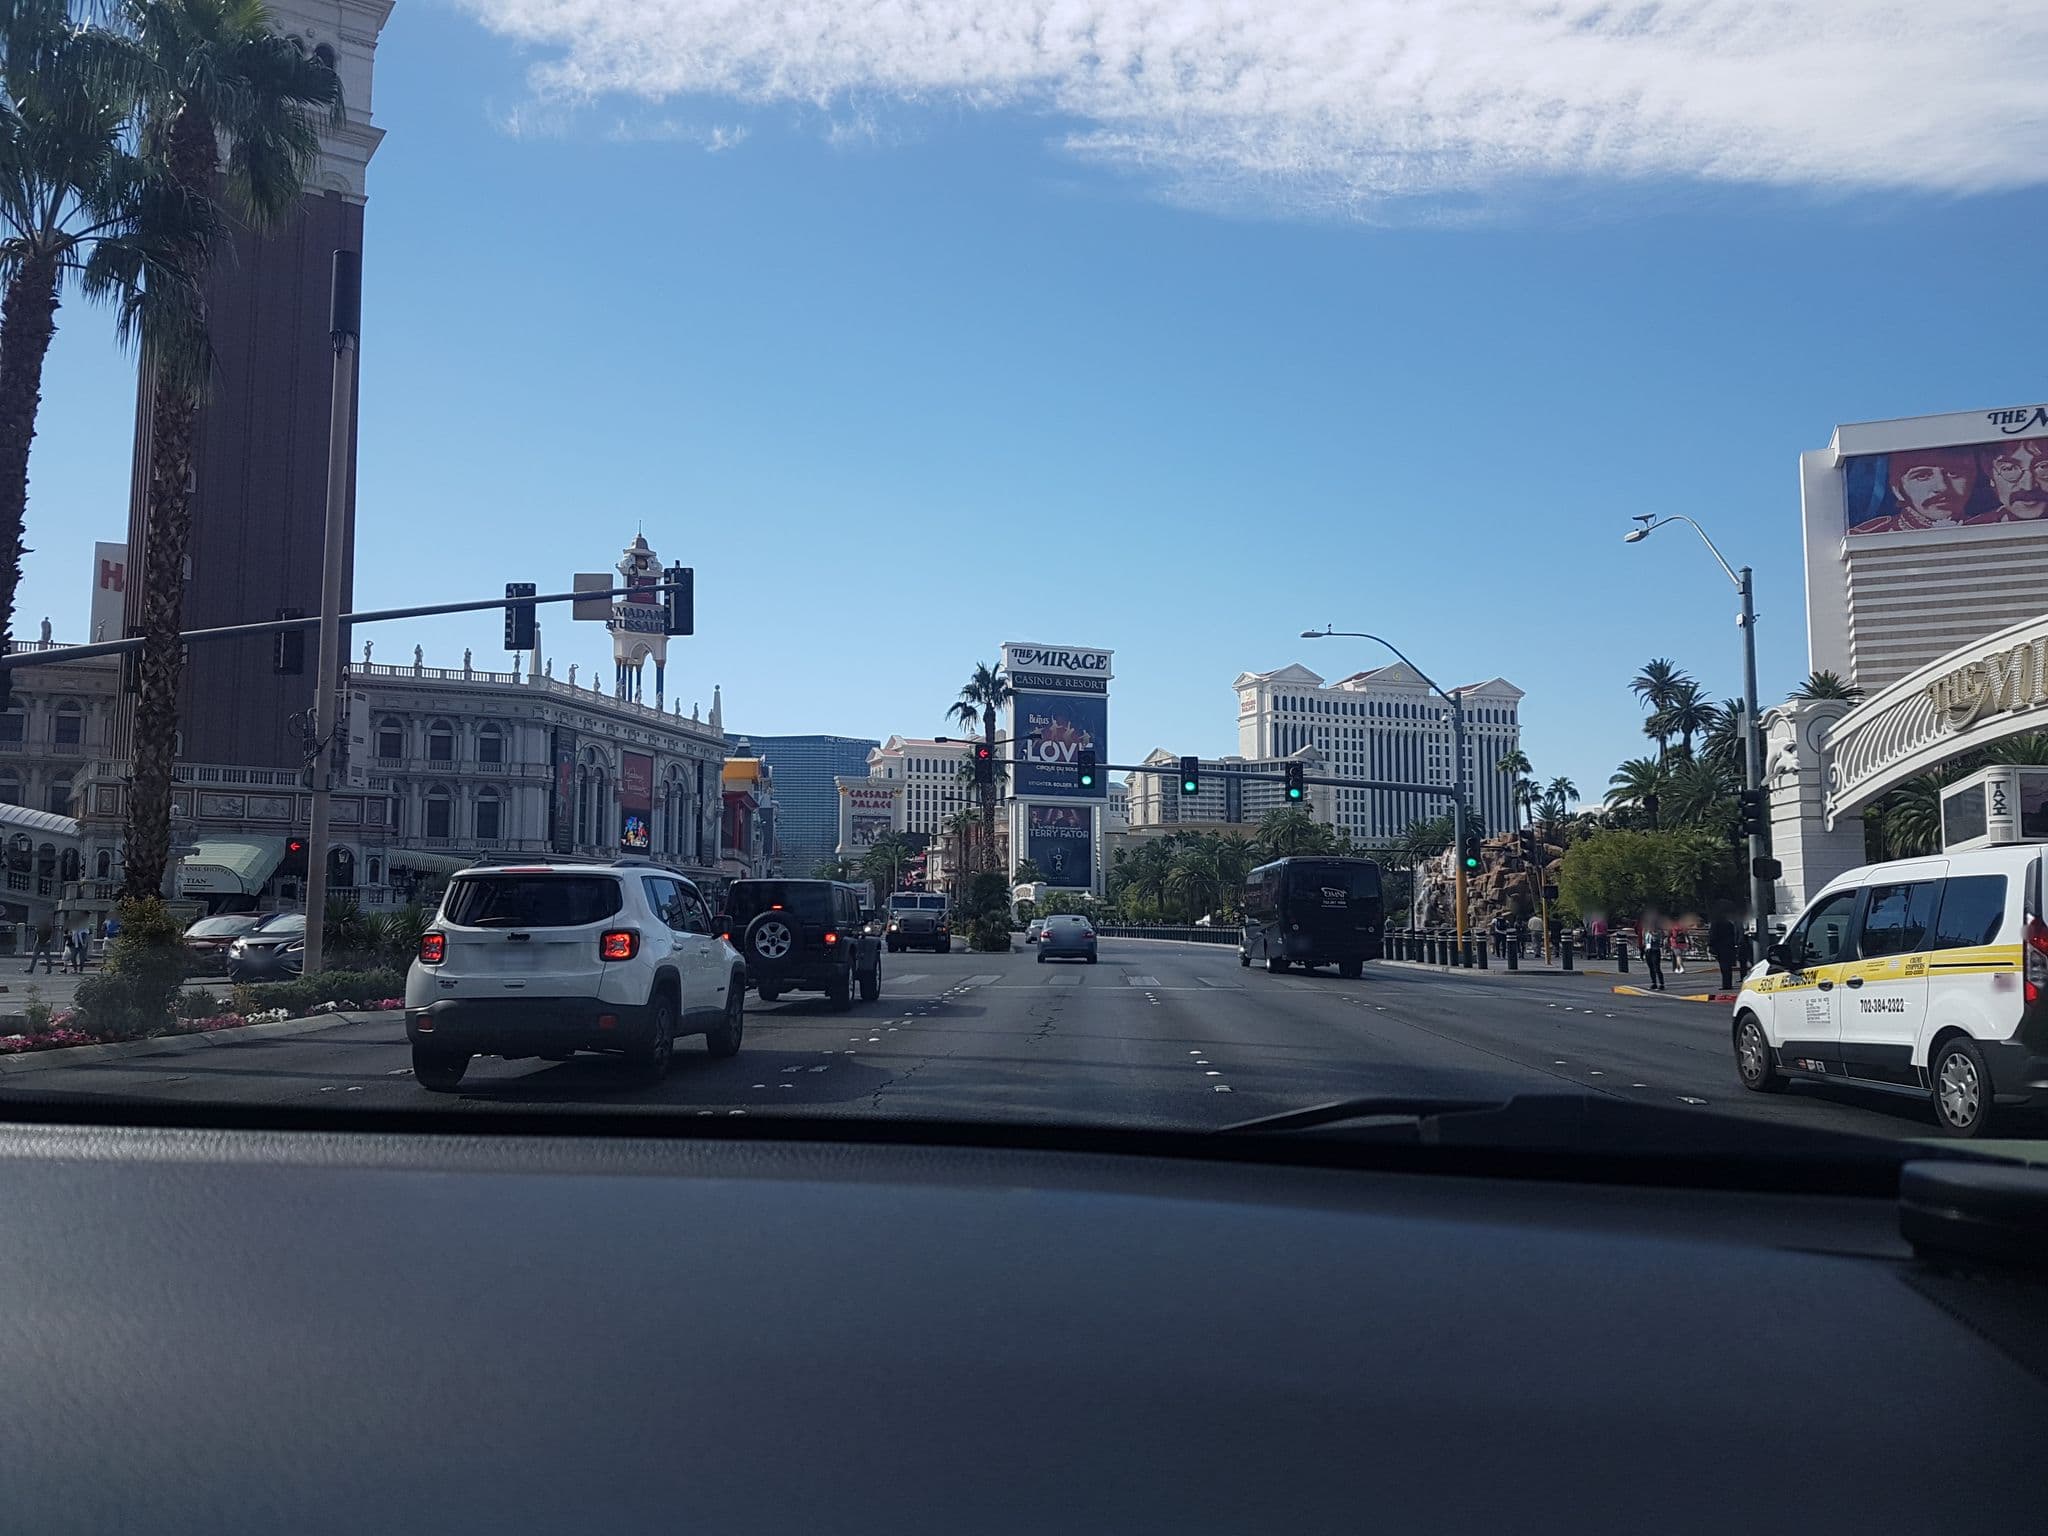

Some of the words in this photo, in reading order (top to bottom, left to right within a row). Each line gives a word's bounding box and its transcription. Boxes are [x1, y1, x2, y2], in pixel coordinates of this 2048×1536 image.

[1987, 409, 2027, 425] THE
[1011, 648, 1033, 659] THE
[1017, 649, 1107, 671] MIRAGE
[1014, 675, 1052, 686] CASINO
[1055, 679, 1063, 687] &
[1065, 679, 1105, 690] RESORT
[1925, 661, 1980, 714] THE
[849, 789, 894, 799] CAESARS
[1991, 780, 2008, 816] TAXI
[851, 800, 891, 809] PALACE
[1030, 829, 1058, 839] TERRY
[1061, 831, 1089, 840] FATOR
[507, 932, 530, 941] Jeep
[1860, 998, 1905, 1013] 702-384-2322
